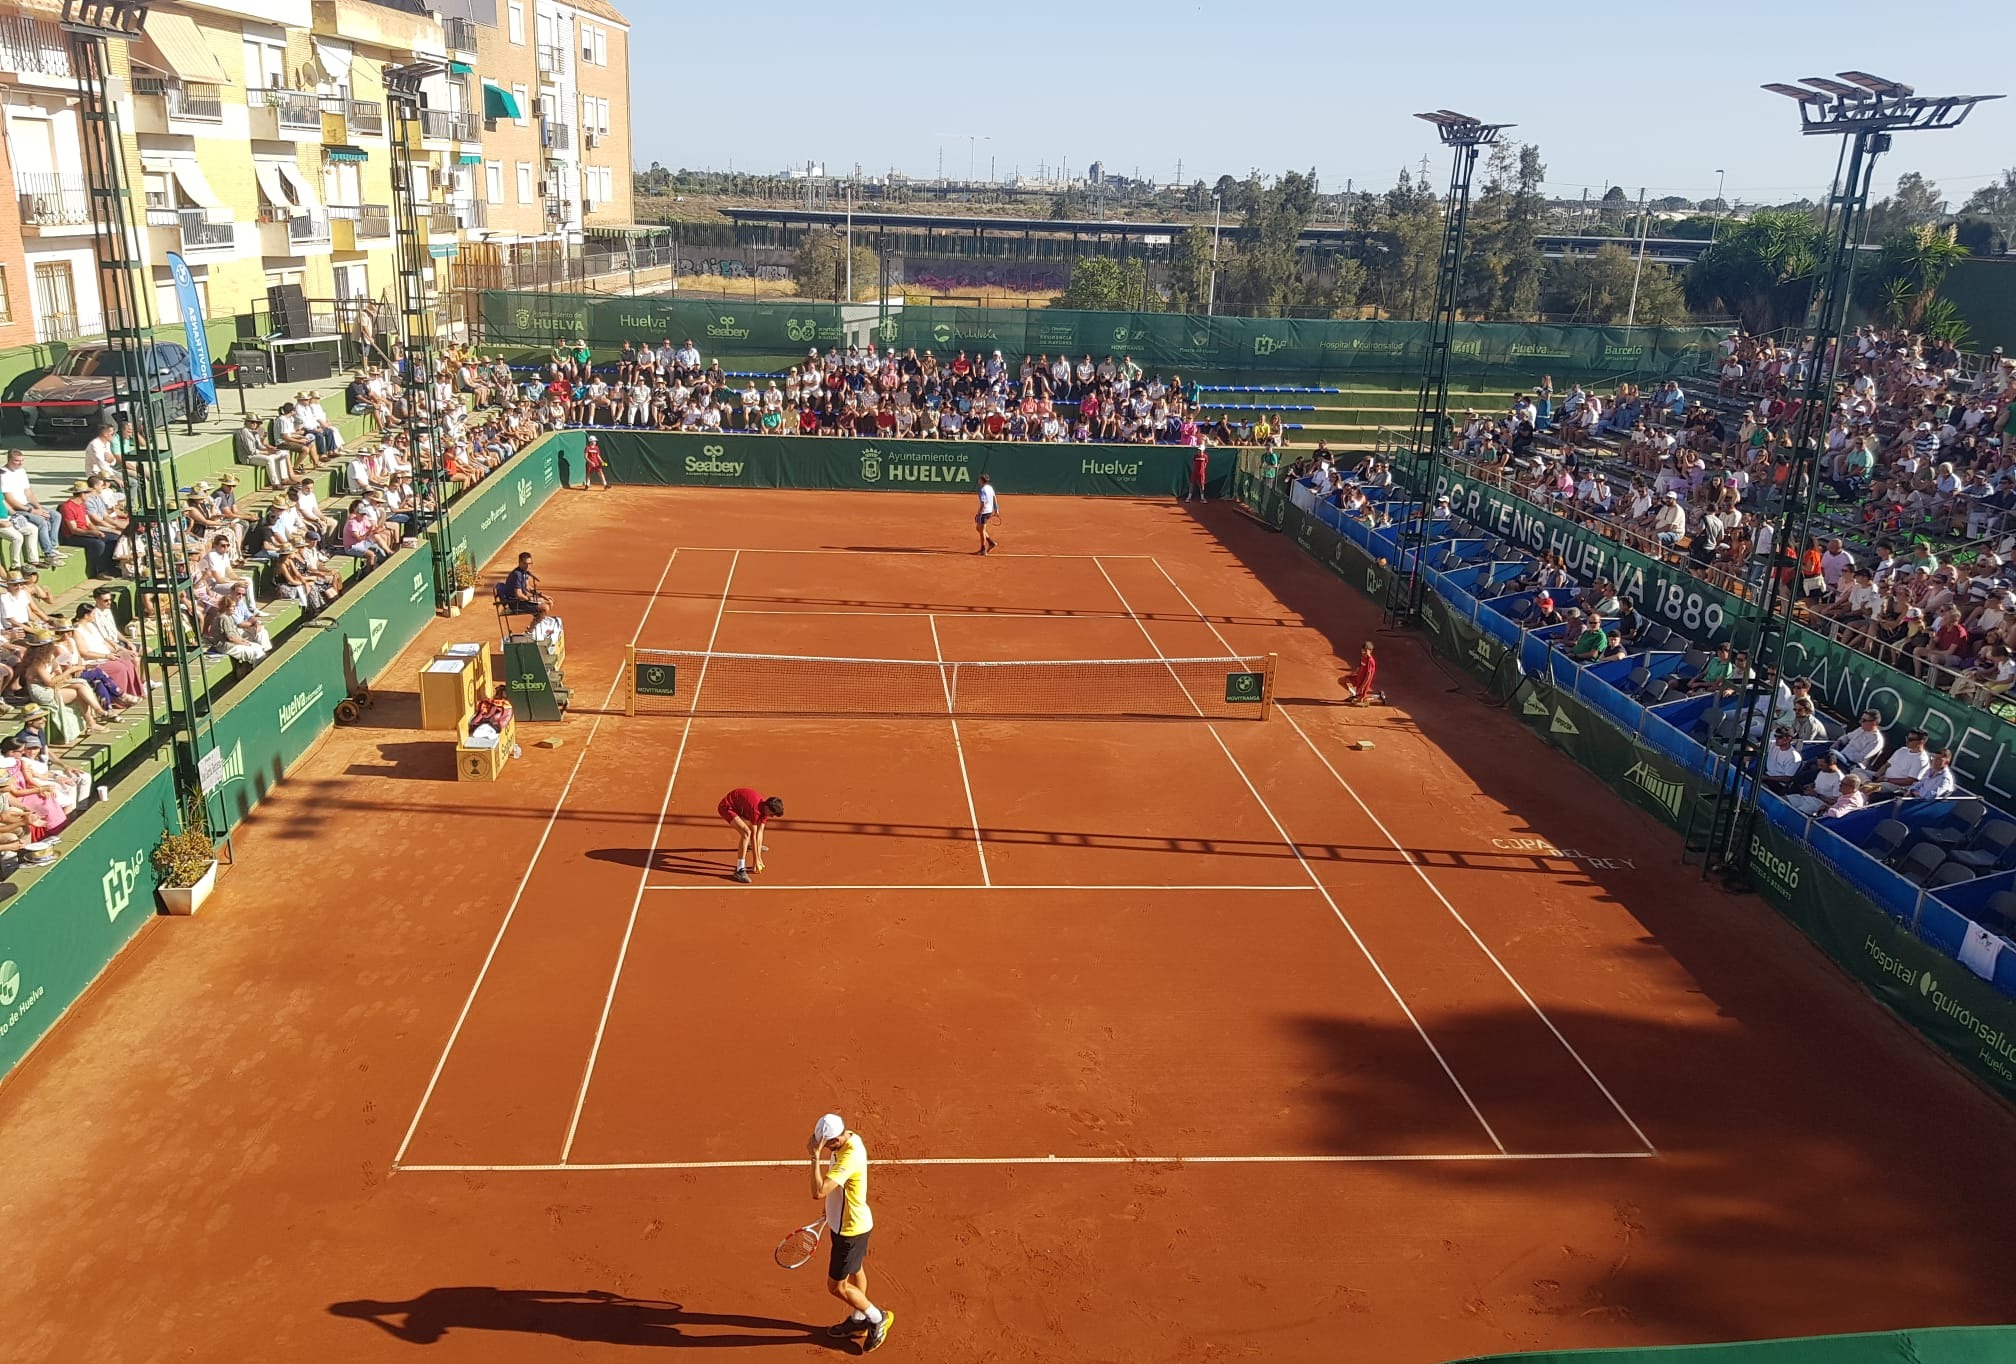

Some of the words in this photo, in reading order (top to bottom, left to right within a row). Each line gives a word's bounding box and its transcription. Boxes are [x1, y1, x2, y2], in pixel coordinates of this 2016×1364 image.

[533, 319, 584, 331] HUELVA
[620, 314, 667, 328] Huelva
[707, 322, 750, 339] Seabery
[1511, 343, 1547, 354] Huelva
[1604, 344, 1642, 355] Barceló
[685, 455, 744, 476] Seabery
[888, 452, 954, 463] Ayuntamiento
[956, 452, 969, 462] de
[888, 464, 971, 482] HUELVA
[1082, 459, 1138, 475] Huelva
[1434, 474, 1481, 522] RC.R.
[1489, 497, 1546, 550] TENIS
[1550, 528, 1645, 605] HUELVA
[1655, 578, 1725, 640] 1889
[1915, 706, 2014, 799] DEL
[511, 679, 547, 691] Seabery
[278, 692, 306, 728] Huelva
[1491, 838, 1556, 851] COPA
[1549, 849, 1591, 858] DEL
[1751, 833, 1801, 890] Barceló
[1588, 858, 1638, 870] REY
[1864, 934, 1918, 987] Hospital
[9, 1011, 19, 1026] de
[19, 985, 44, 1017] Huelva
[1978, 1047, 2013, 1081] Huelva
